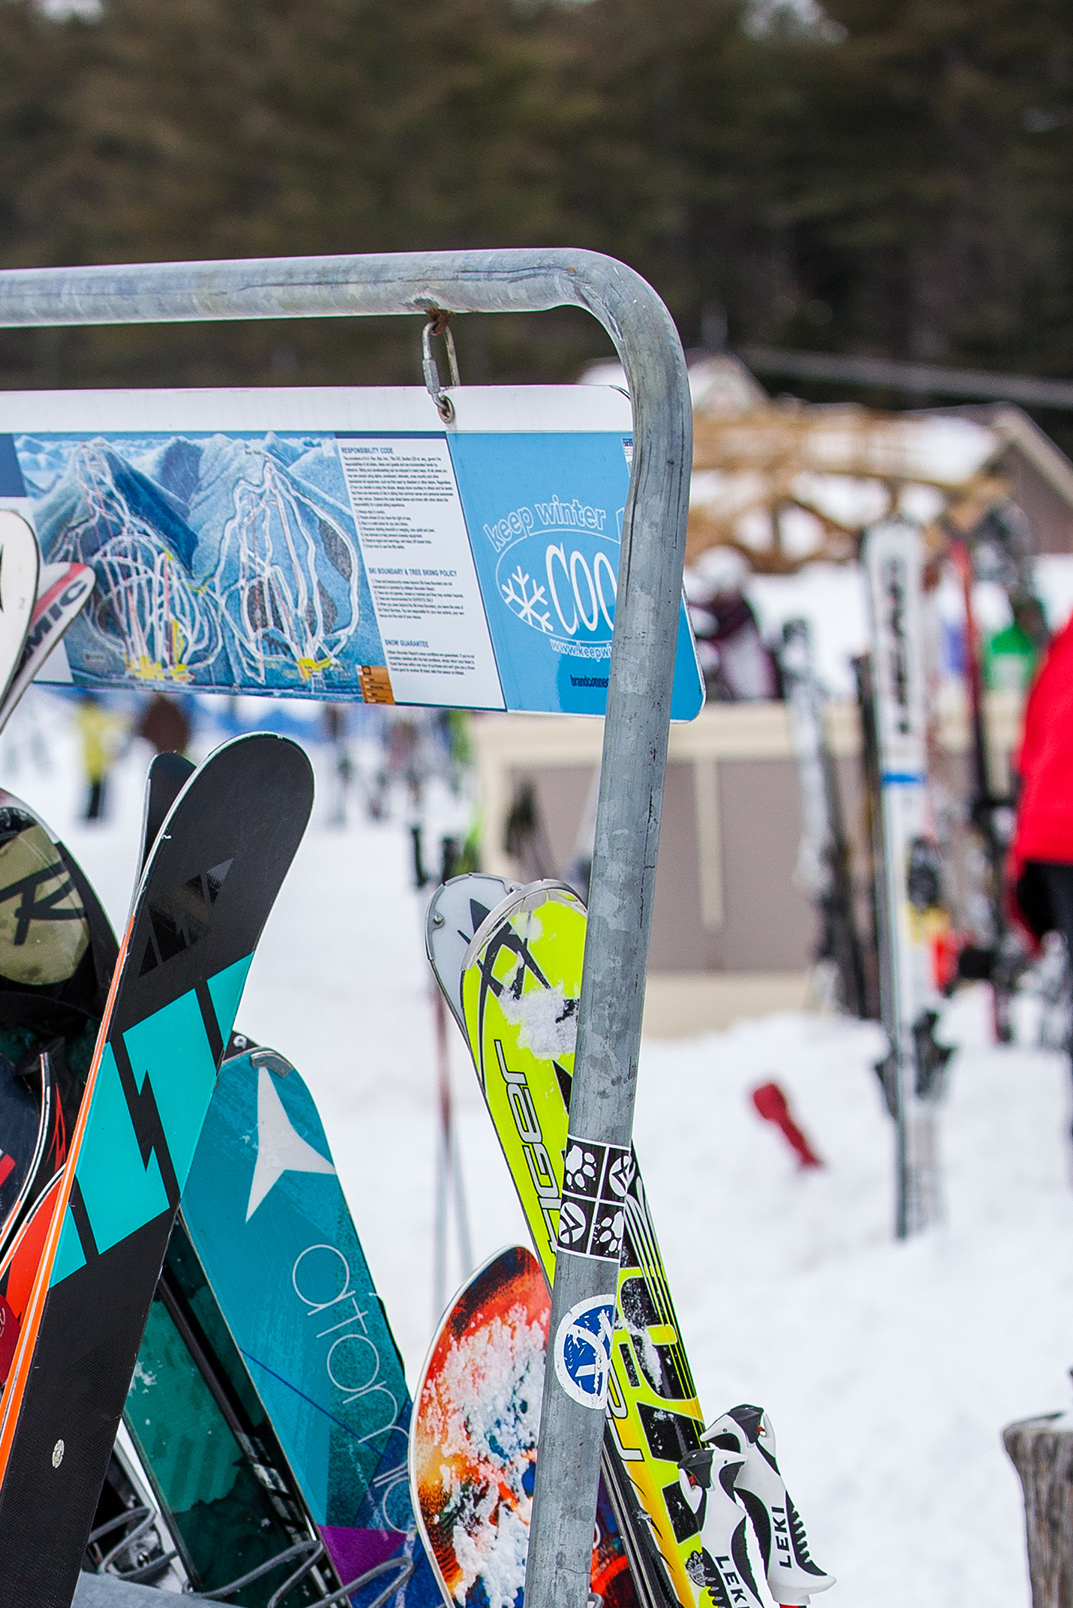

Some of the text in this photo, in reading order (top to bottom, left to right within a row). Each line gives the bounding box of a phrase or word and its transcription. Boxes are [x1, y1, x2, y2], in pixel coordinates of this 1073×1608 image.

[380, 447, 394, 455] CODE
[483, 506, 535, 553] keep
[535, 494, 607, 531] winter
[545, 542, 620, 635] COO
[400, 640, 429, 648] GUARANTEE
[550, 639, 612, 662] www.keepwi
[778, 1505, 792, 1569] LEKI
